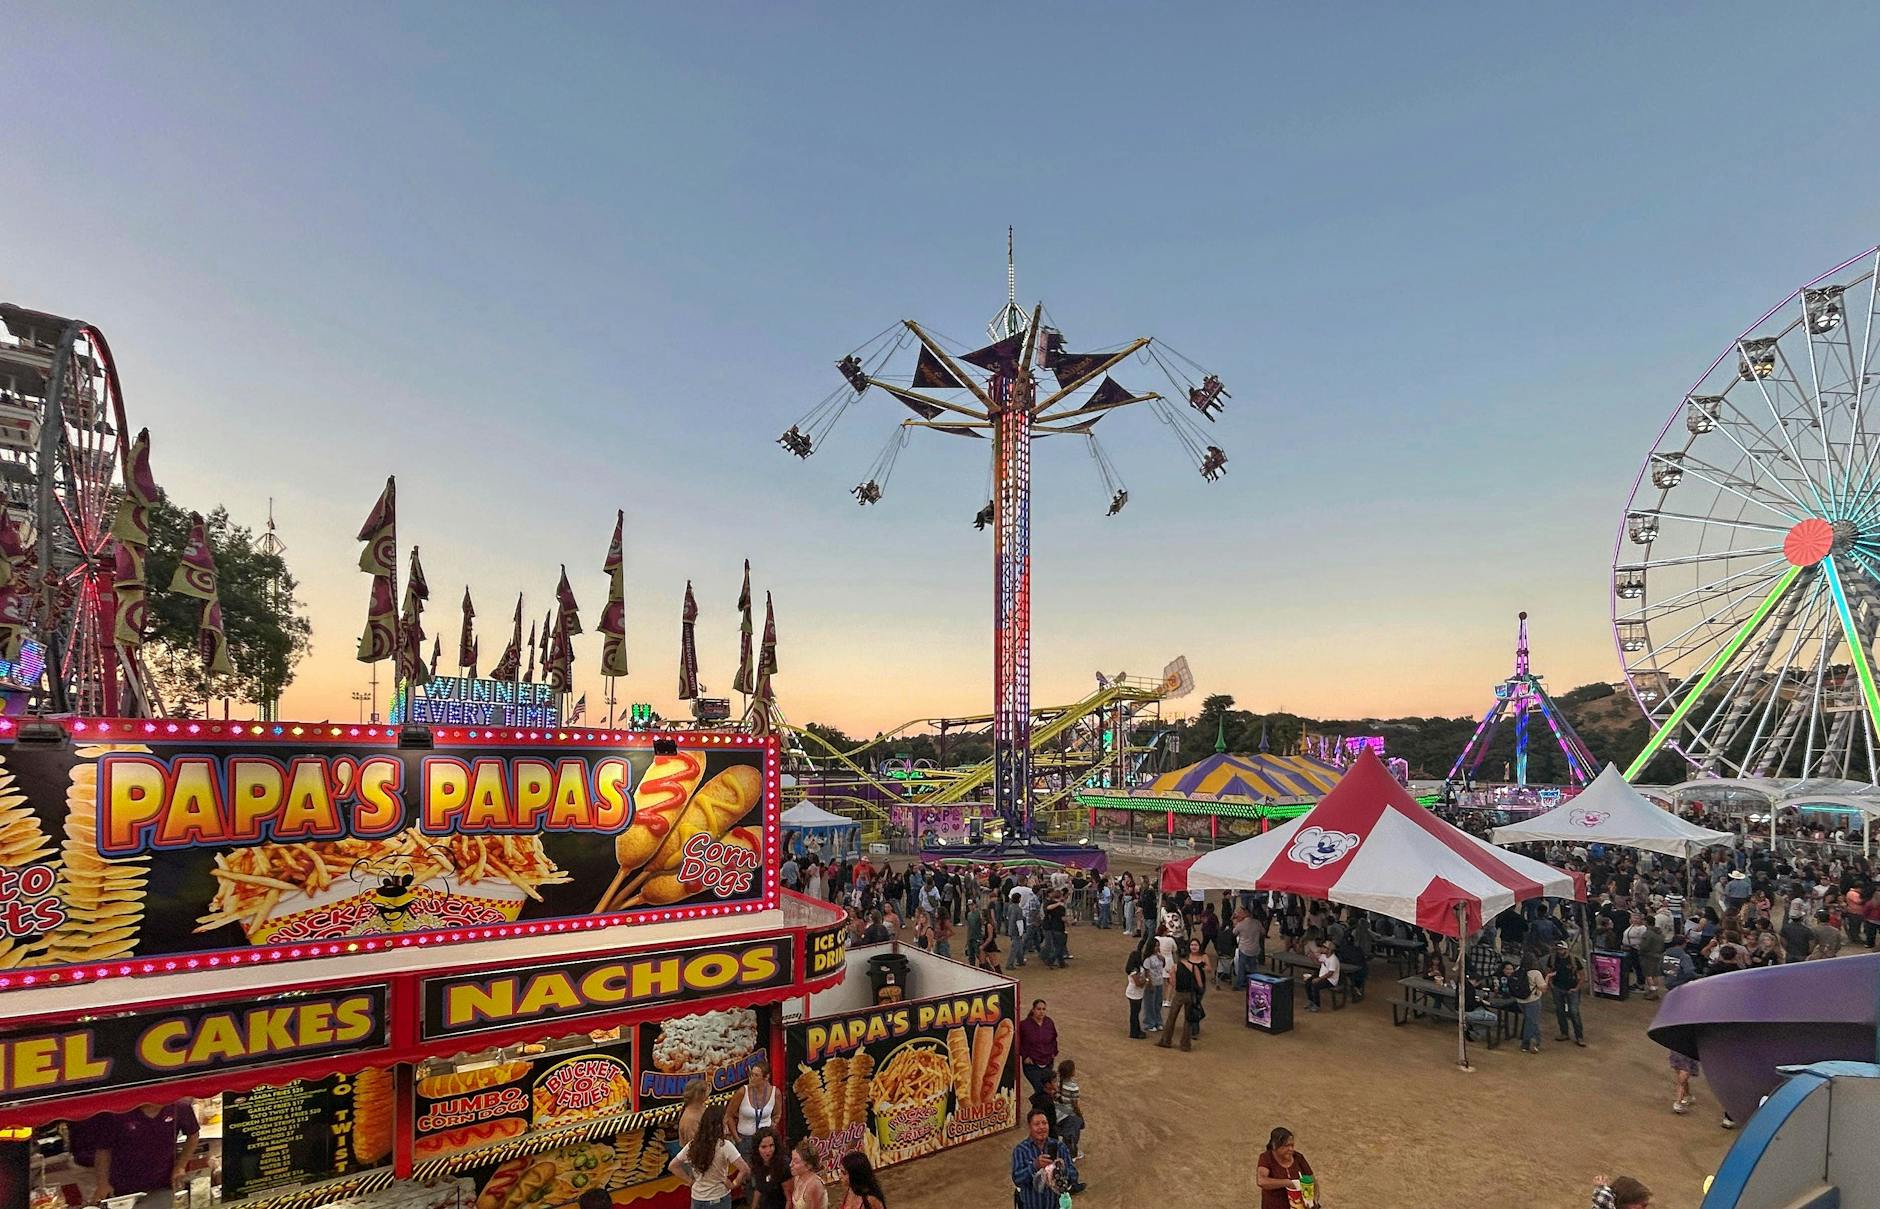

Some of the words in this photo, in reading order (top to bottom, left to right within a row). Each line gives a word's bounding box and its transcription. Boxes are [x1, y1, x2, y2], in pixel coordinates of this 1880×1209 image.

[425, 676, 551, 705] WINNER
[413, 700, 495, 725] EVERY
[503, 704, 557, 728] TIME
[102, 756, 401, 852] PAPA'S
[423, 757, 630, 833] PAPAS
[684, 833, 757, 868] Corn
[678, 856, 753, 897] Dogs
[814, 933, 834, 952] ICE
[448, 947, 777, 1025] NACHOS
[807, 1011, 909, 1063] PAPA'S
[918, 995, 1001, 1030] PAPAS
[0, 1033, 108, 1091] EL
[140, 997, 373, 1068] CAKES
[545, 1060, 620, 1093] BUCKET
[248, 1091, 272, 1102] ASADA
[248, 1104, 273, 1114] GARLIC
[273, 1101, 292, 1110] FRIES
[428, 1087, 522, 1116] JUMBO
[556, 1080, 611, 1109] FRIES
[229, 1119, 260, 1130] CHICKEN
[261, 1115, 283, 1124] STRIPS
[242, 1123, 273, 1133] CHICKEN
[273, 1118, 296, 1128] STRIPS
[249, 1111, 268, 1120] TATO
[269, 1108, 289, 1116] TWIST
[417, 1113, 476, 1132] CORN
[478, 1094, 529, 1120] DOGS
[251, 1128, 271, 1138] CORN
[330, 1109, 353, 1172] TWIST
[948, 1121, 979, 1138] CORN
